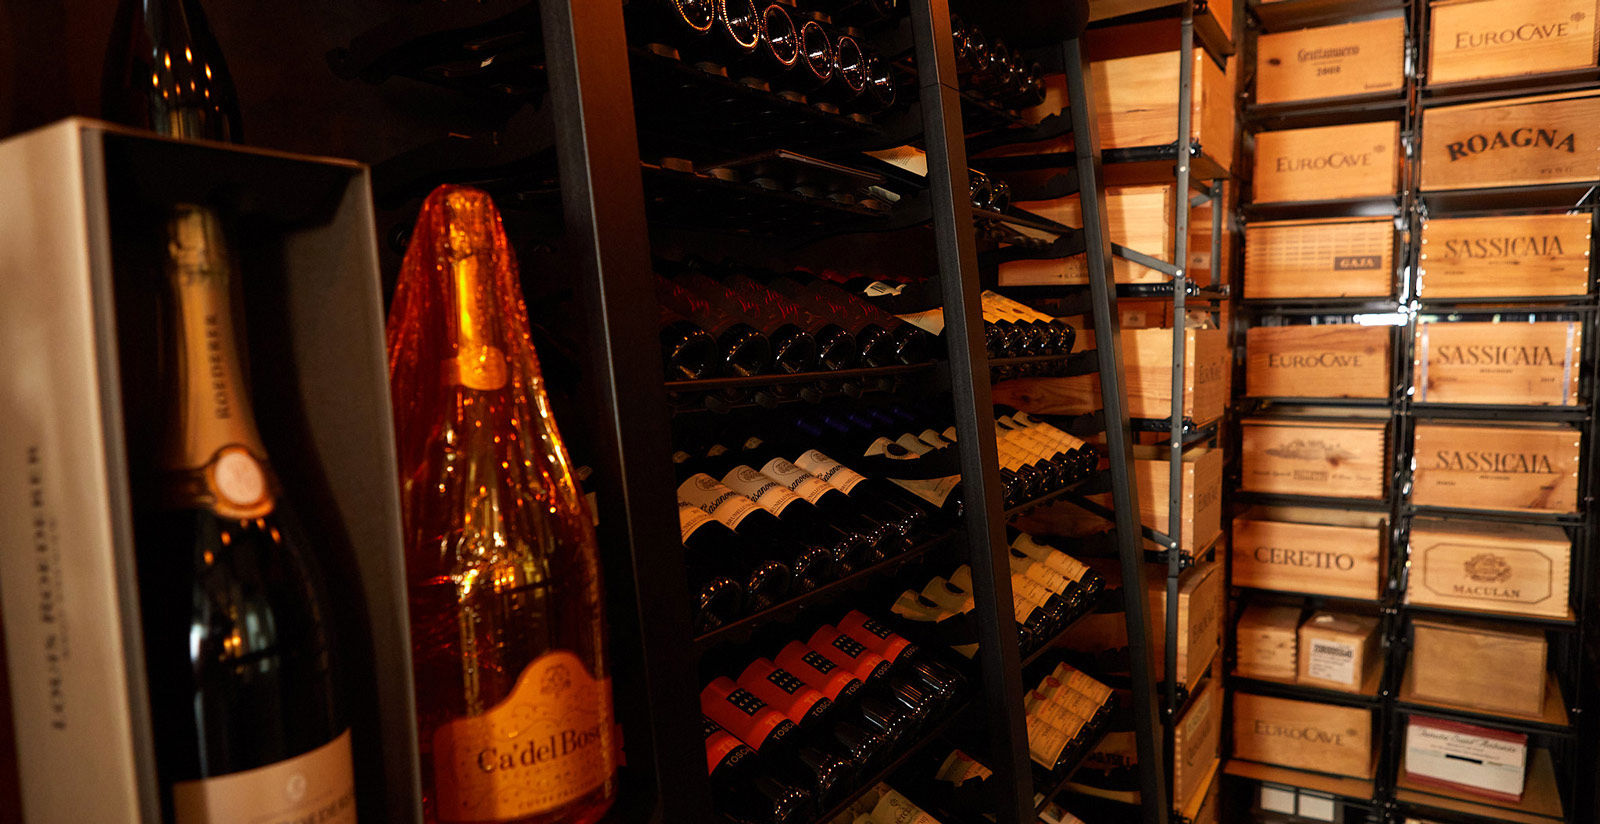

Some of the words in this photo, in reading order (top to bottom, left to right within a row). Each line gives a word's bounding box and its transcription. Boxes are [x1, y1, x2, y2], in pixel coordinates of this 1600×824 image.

[1446, 128, 1576, 162] ROAGNA
[1444, 235, 1564, 259] SASSICAIA
[1437, 345, 1554, 366] SASSICAIA
[1436, 450, 1553, 474] SASSICAIA
[1254, 546, 1355, 572] CERETTO
[1453, 584, 1521, 598] MACULAN
